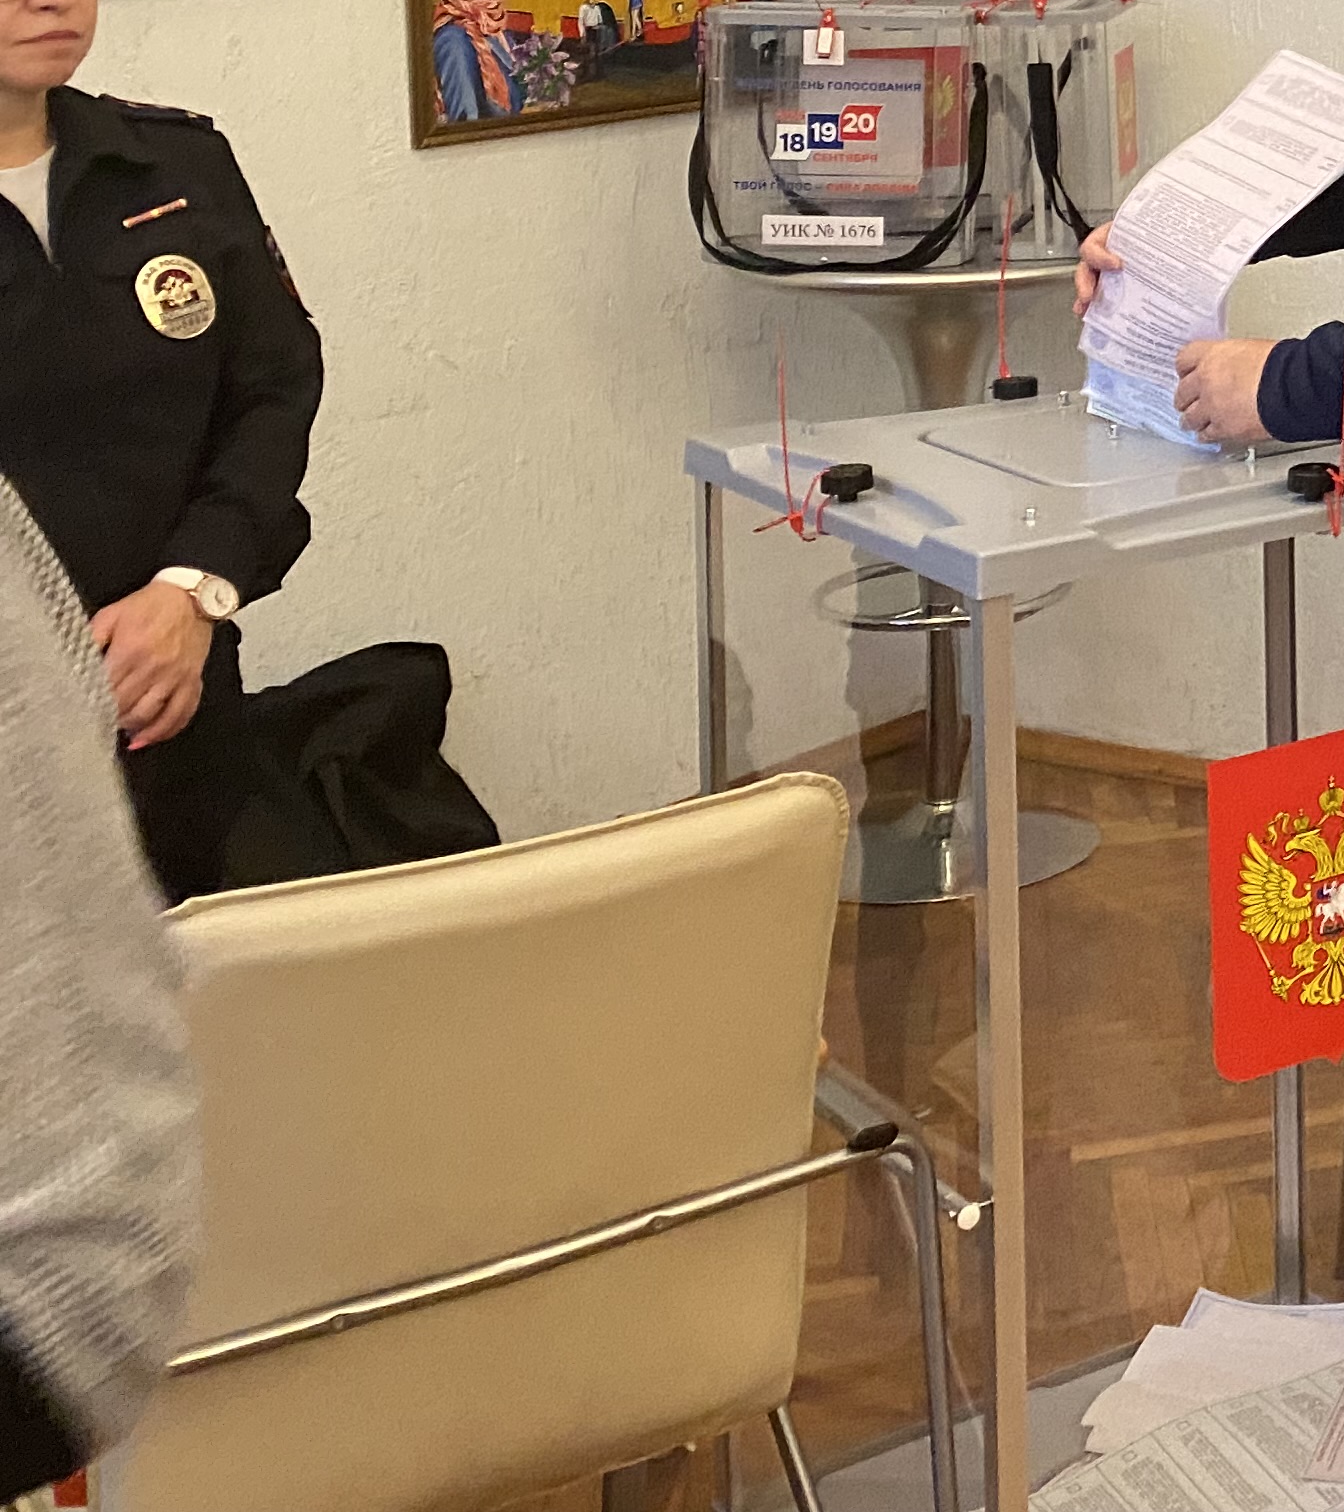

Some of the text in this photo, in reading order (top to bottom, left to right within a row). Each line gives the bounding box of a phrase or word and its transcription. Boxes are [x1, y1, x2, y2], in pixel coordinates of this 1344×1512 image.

[827, 81, 922, 92] ГОЛОСОВАНИЯ
[779, 112, 876, 153] 18 19 20
[812, 152, 879, 164] СЕНТЯБРЯ
[769, 180, 812, 192] ГЛОС
[770, 223, 877, 238] УИК № 1676
